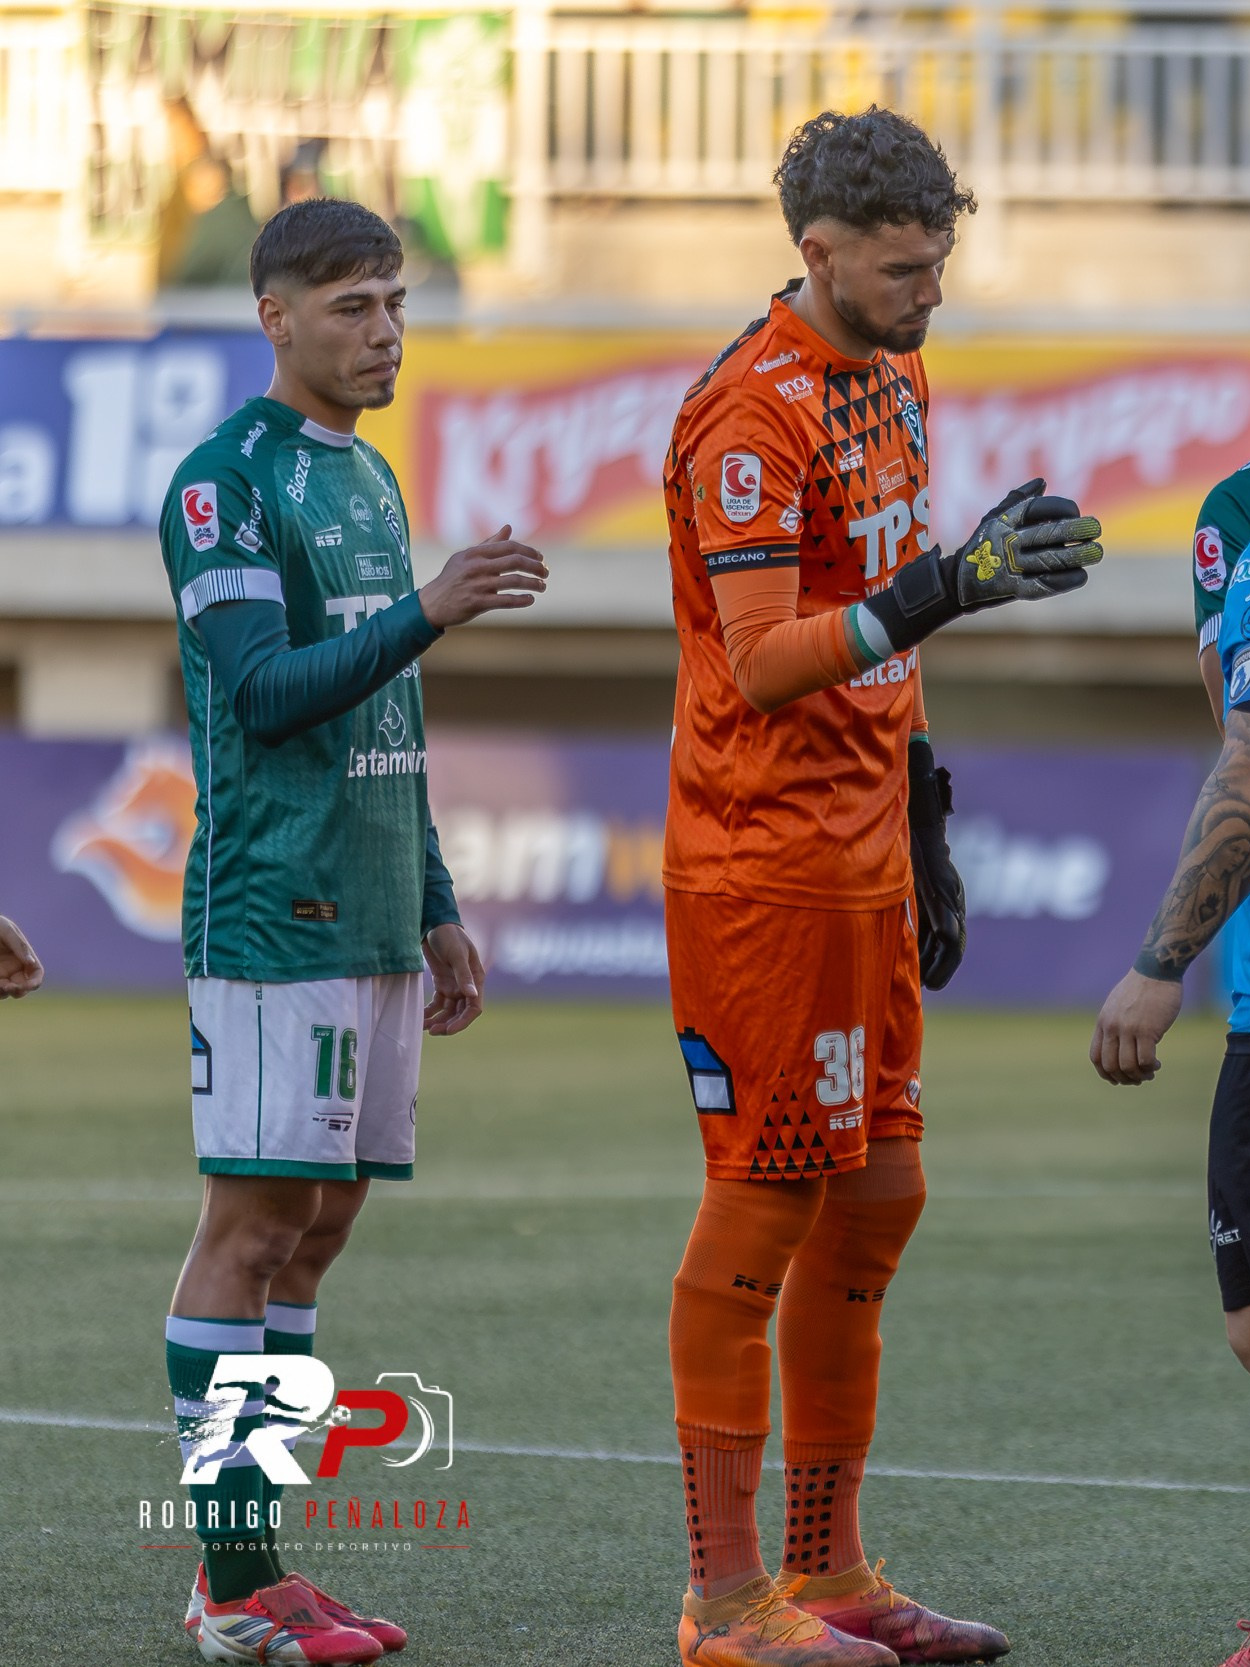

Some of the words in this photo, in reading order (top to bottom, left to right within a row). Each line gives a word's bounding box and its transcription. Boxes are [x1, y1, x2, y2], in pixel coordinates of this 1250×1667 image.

[286, 449, 312, 505] Biozen
[708, 557, 717, 566] EL
[718, 552, 765, 565] DECANO
[849, 488, 929, 580] TPS
[311, 1024, 357, 1103] 16
[814, 1025, 865, 1106] 36
